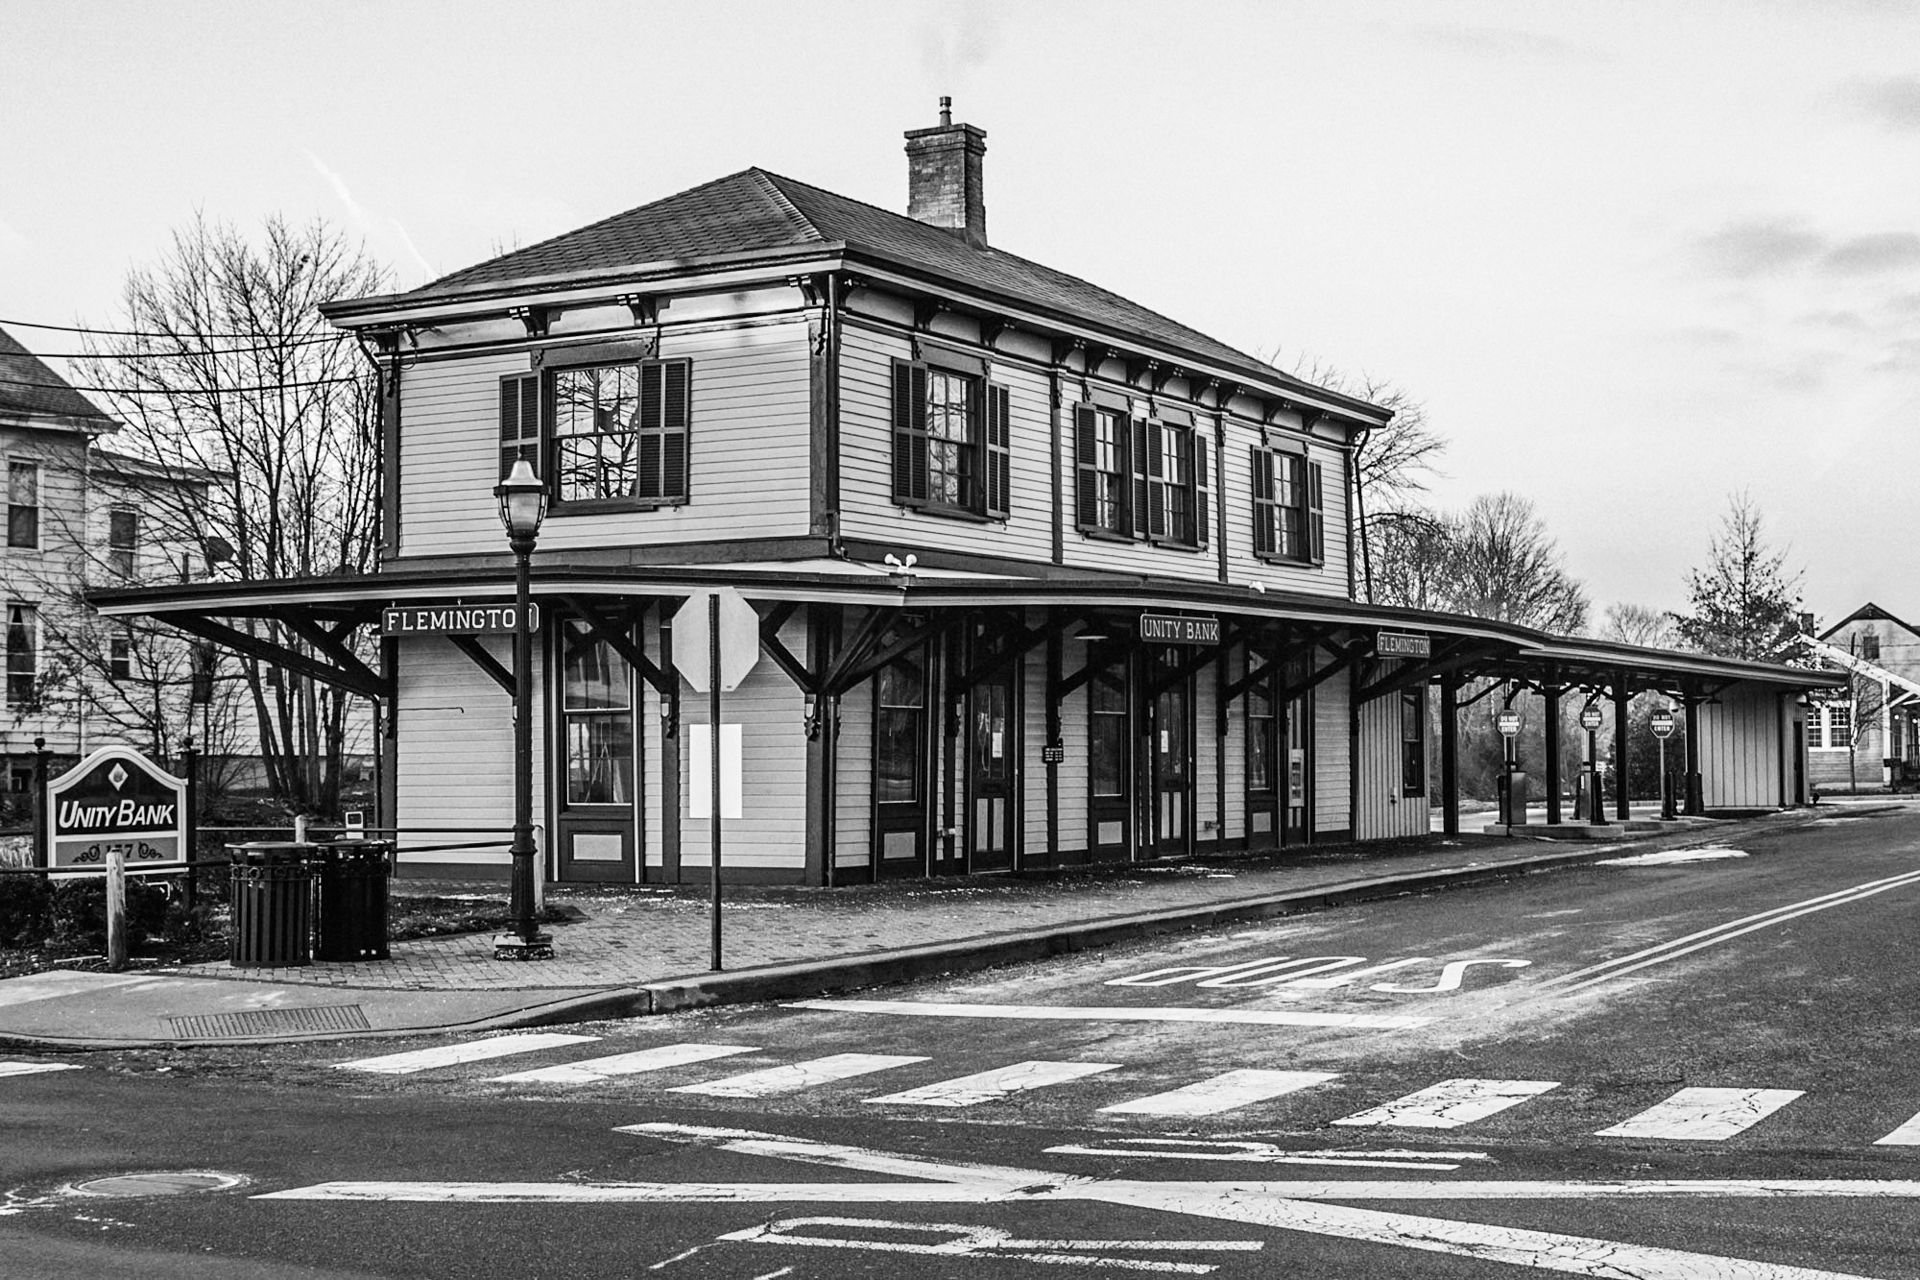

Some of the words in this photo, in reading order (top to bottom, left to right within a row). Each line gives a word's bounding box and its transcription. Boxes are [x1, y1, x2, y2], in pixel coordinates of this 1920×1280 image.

[387, 608, 532, 631] FLEMINGTO
[1144, 619, 1181, 638] UNITY
[1187, 622, 1218, 640] BANK
[1380, 636, 1429, 654] FLEMINGTON
[59, 801, 117, 828] UNITY
[116, 799, 174, 826] BANK
